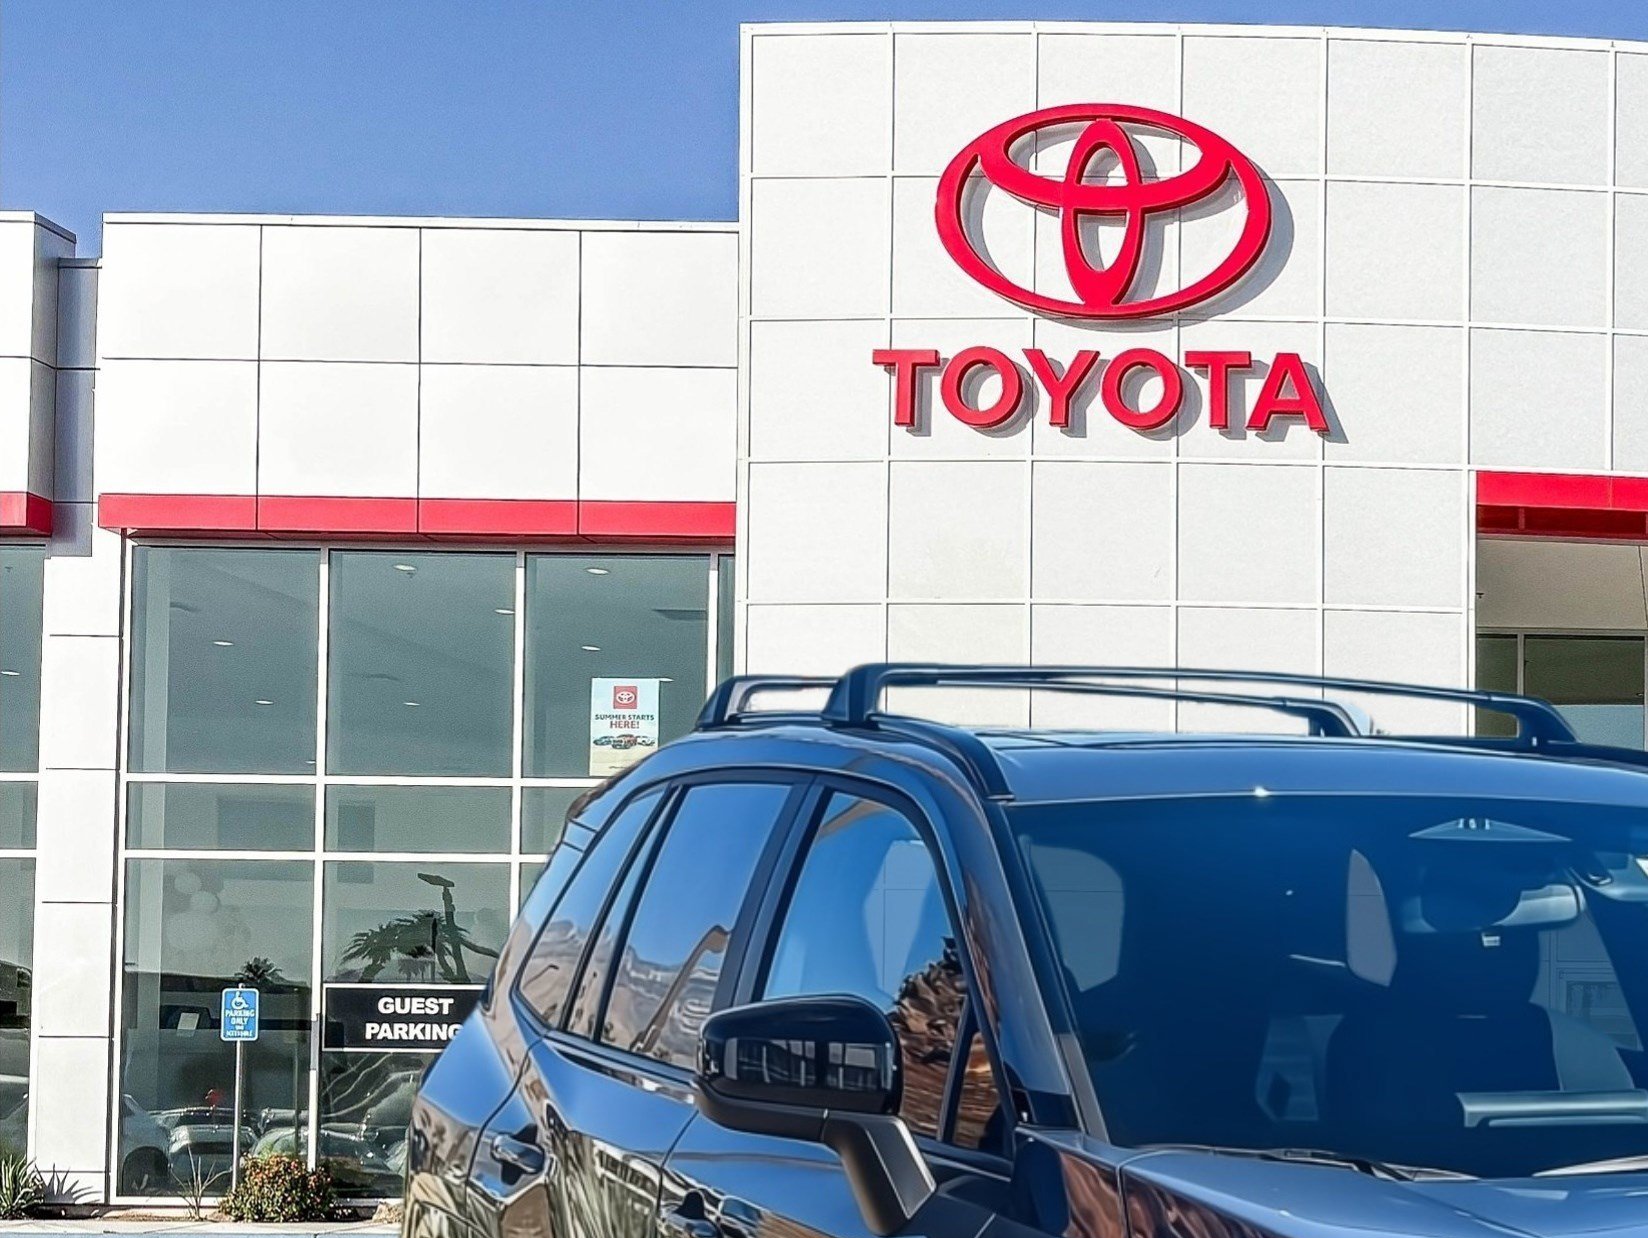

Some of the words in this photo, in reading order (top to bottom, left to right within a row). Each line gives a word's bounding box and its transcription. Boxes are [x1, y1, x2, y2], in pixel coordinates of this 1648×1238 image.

[872, 346, 1329, 434] TOYOTA
[610, 720, 640, 729] HERE!
[377, 997, 455, 1015] GUEST
[225, 1009, 256, 1018] PARKING
